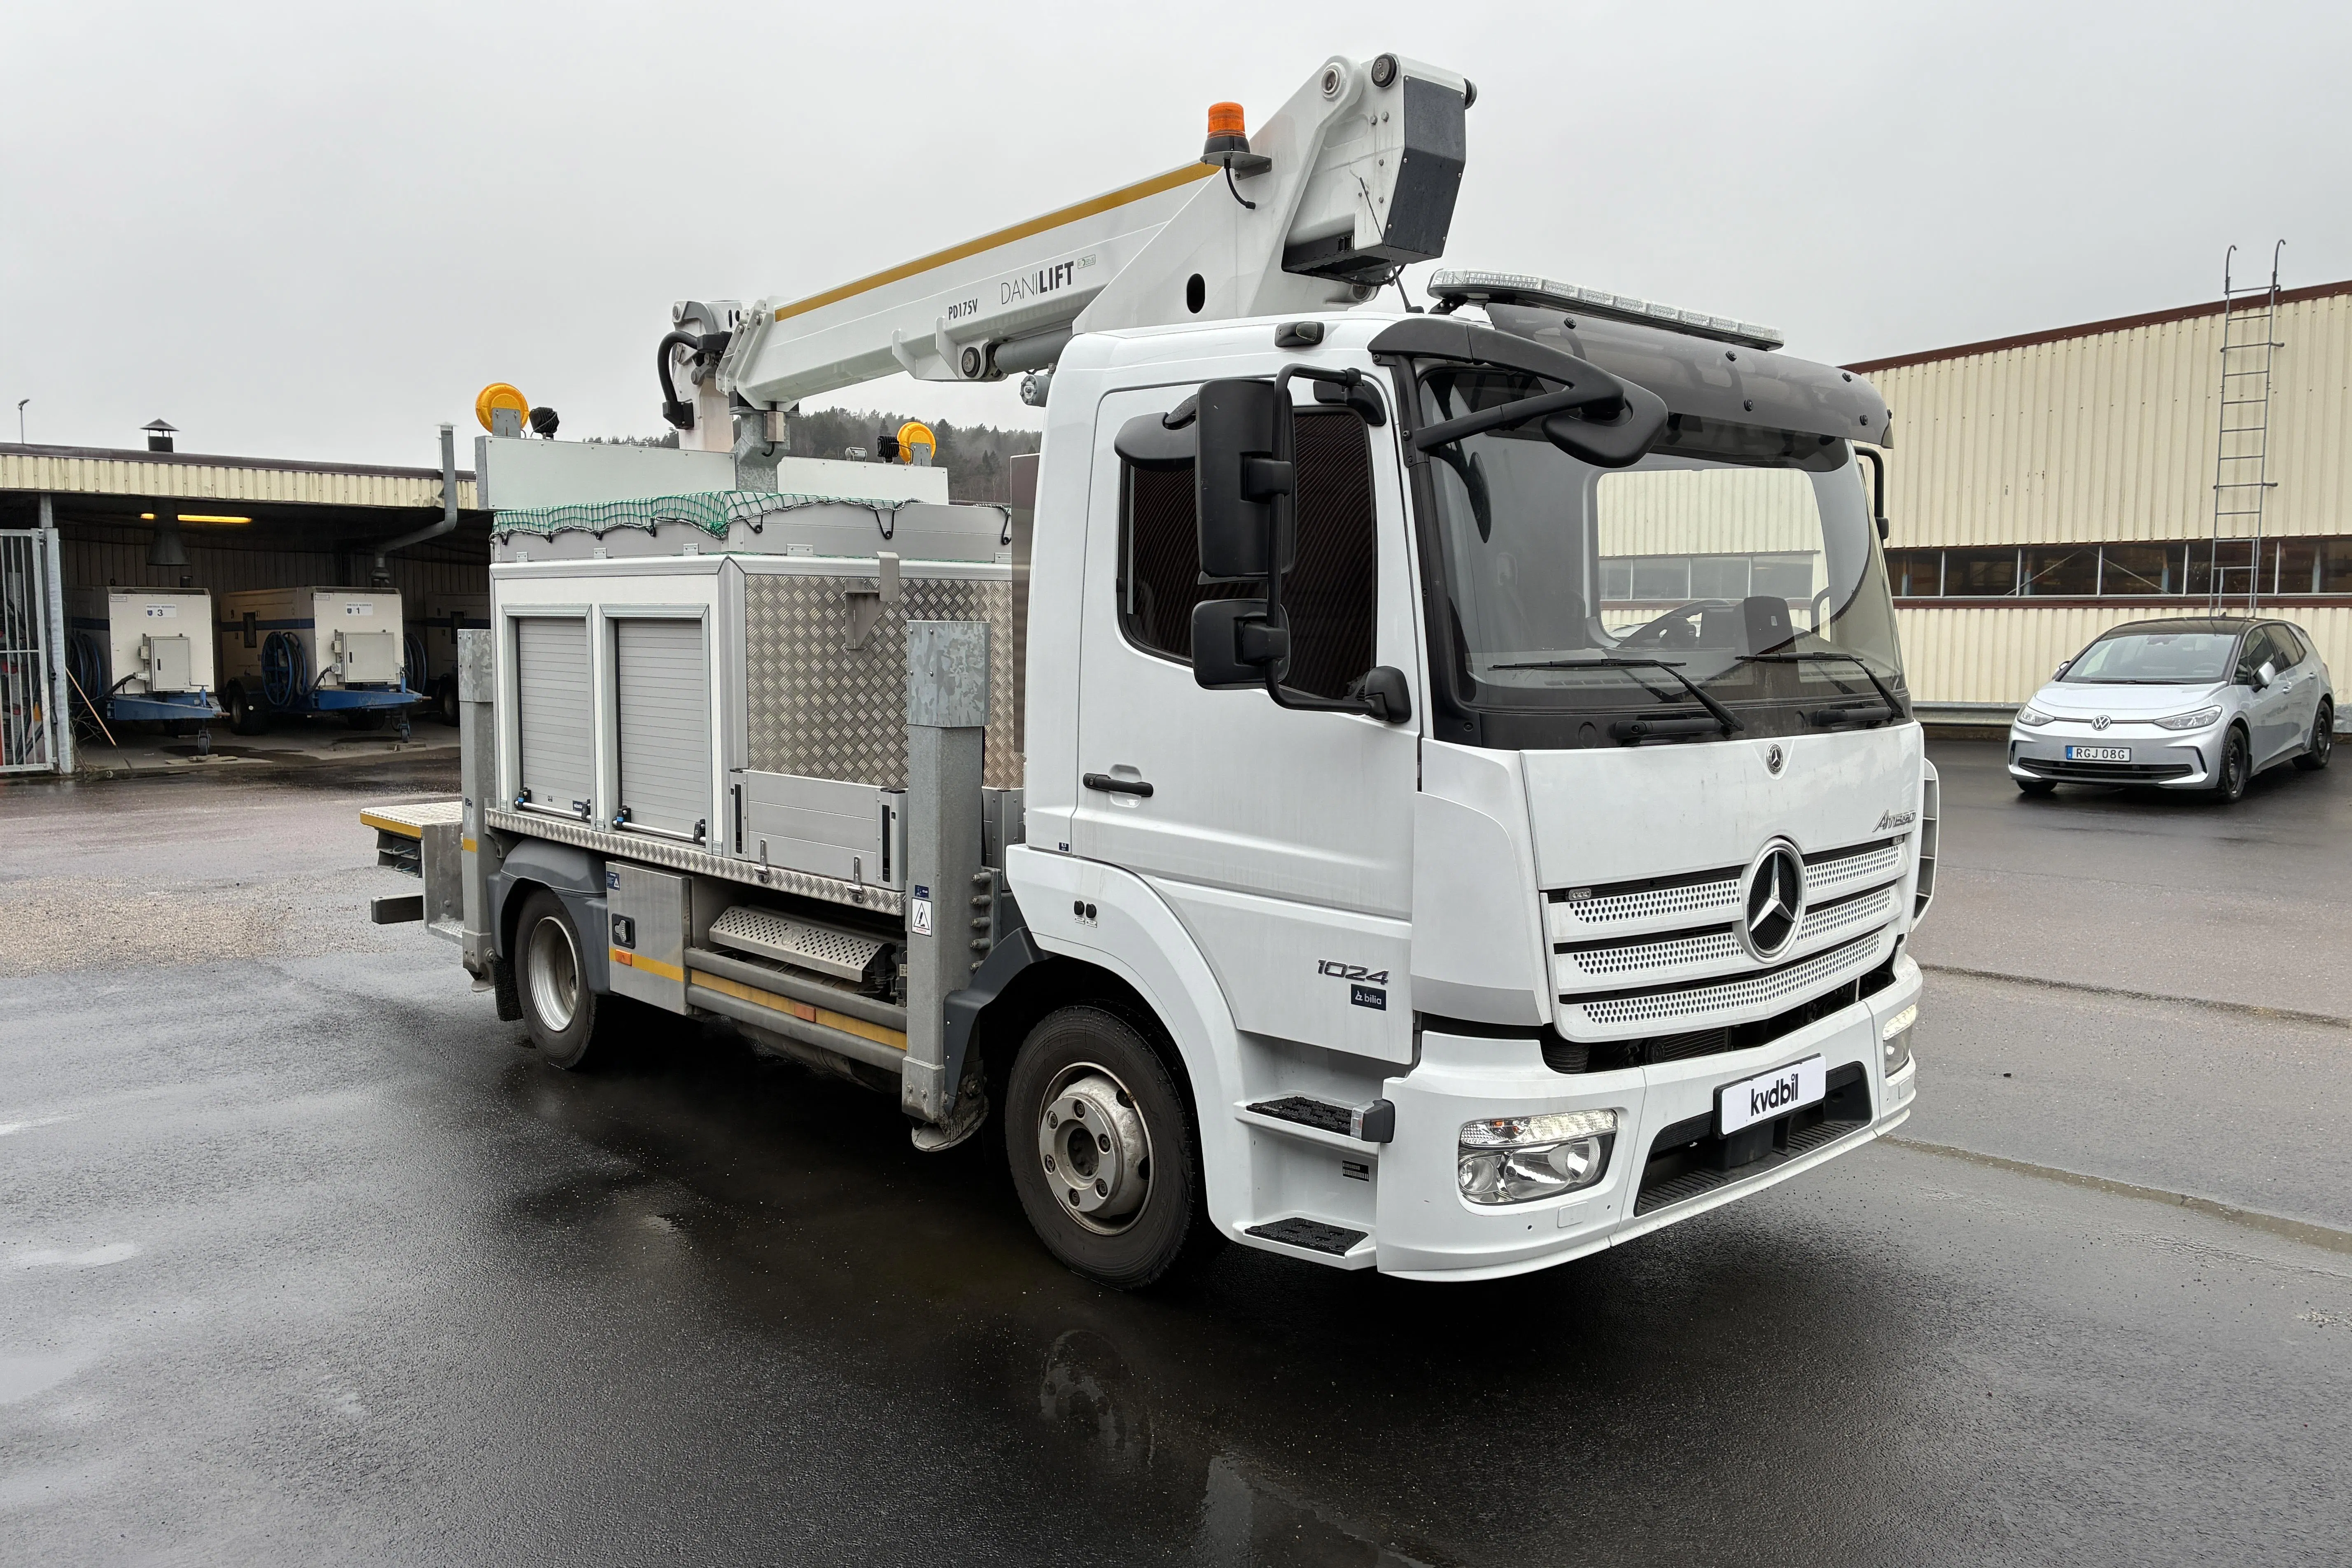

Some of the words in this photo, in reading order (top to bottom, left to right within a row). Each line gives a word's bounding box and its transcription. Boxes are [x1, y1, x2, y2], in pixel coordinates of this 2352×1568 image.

[1001, 261, 1074, 305] DANILIFT
[948, 298, 978, 320] PD175V
[2076, 748, 2098, 758] RGJ
[2102, 749, 2125, 759] 08G
[1318, 958, 1389, 985] 1024
[1364, 993, 1382, 1005] bilia
[1750, 1073, 1799, 1116] kvdbil
